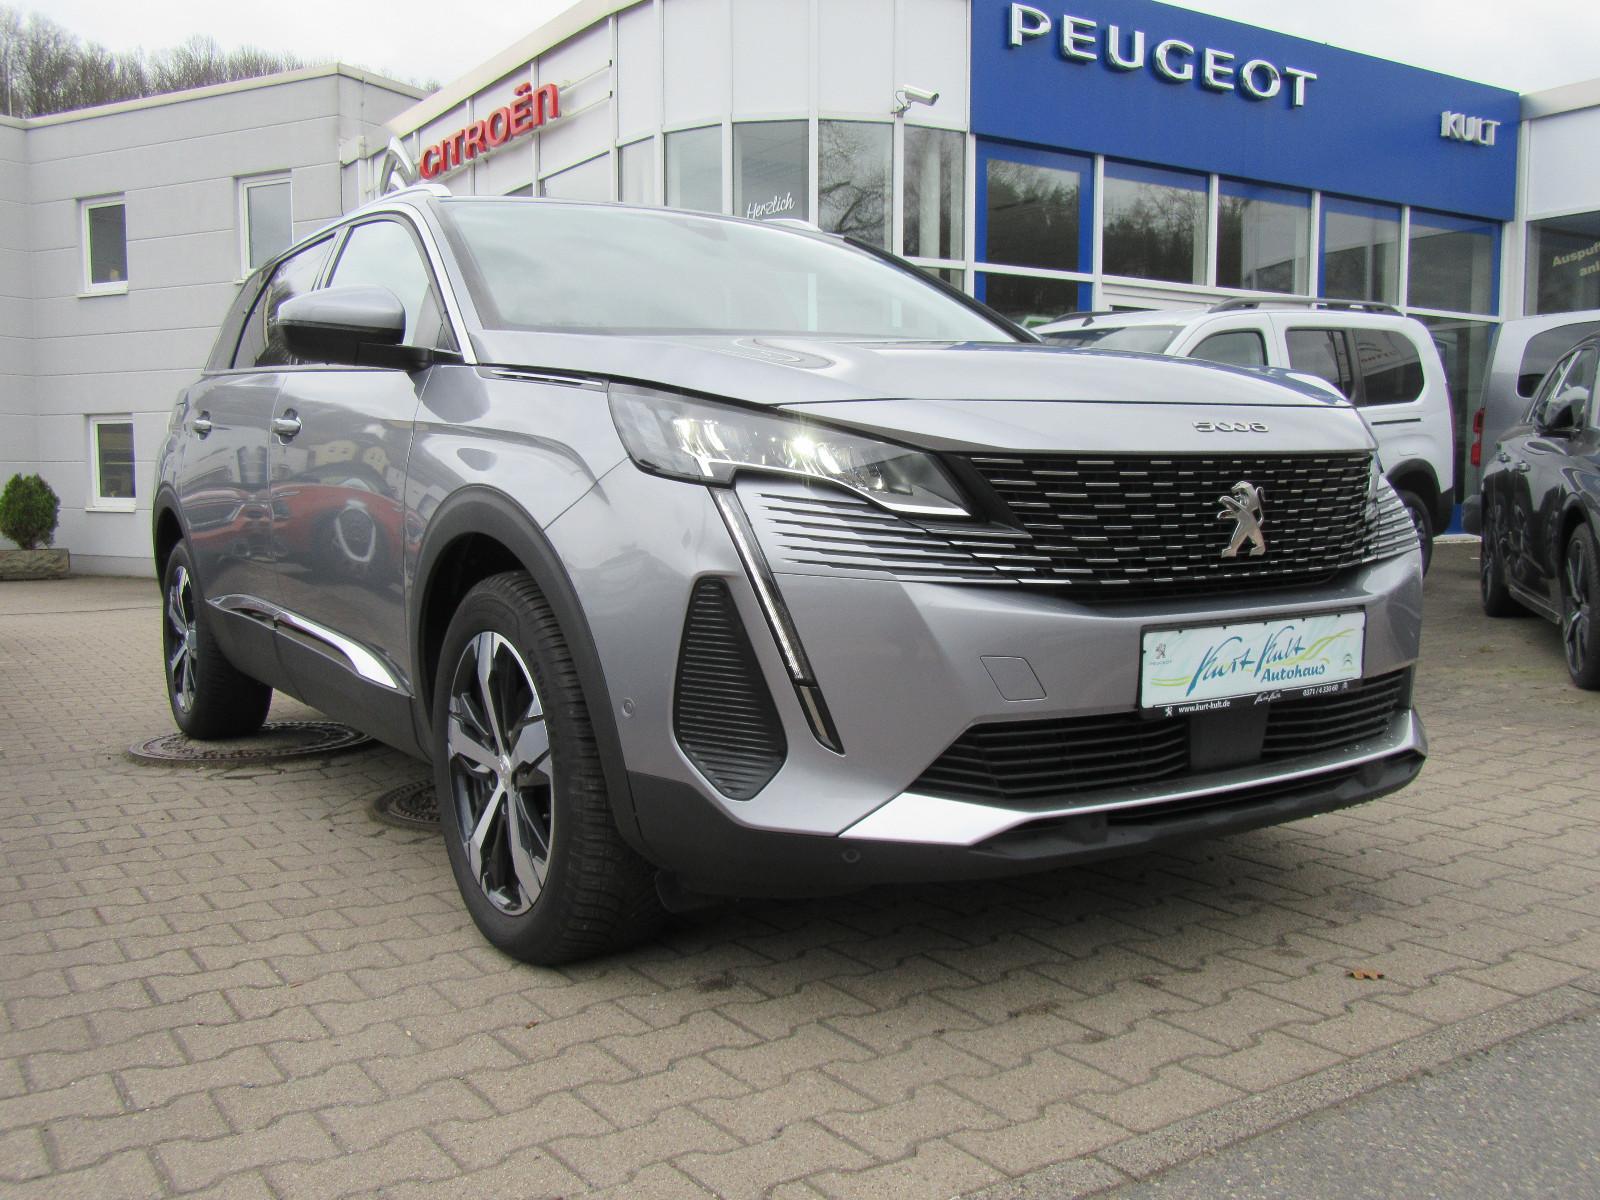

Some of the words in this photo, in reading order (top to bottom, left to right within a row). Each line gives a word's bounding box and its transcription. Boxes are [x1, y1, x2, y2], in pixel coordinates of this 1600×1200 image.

[1009, 2, 1317, 107] PEUGEOT
[1440, 111, 1501, 146] KULT
[746, 191, 796, 220] Herzlich
[1552, 241, 1600, 267] Auspuf
[1186, 636, 1256, 697] Kurt
[1253, 625, 1306, 678] Kult
[1261, 663, 1326, 683] Autohaus
[1178, 700, 1231, 713] www.kurt-kult.de
